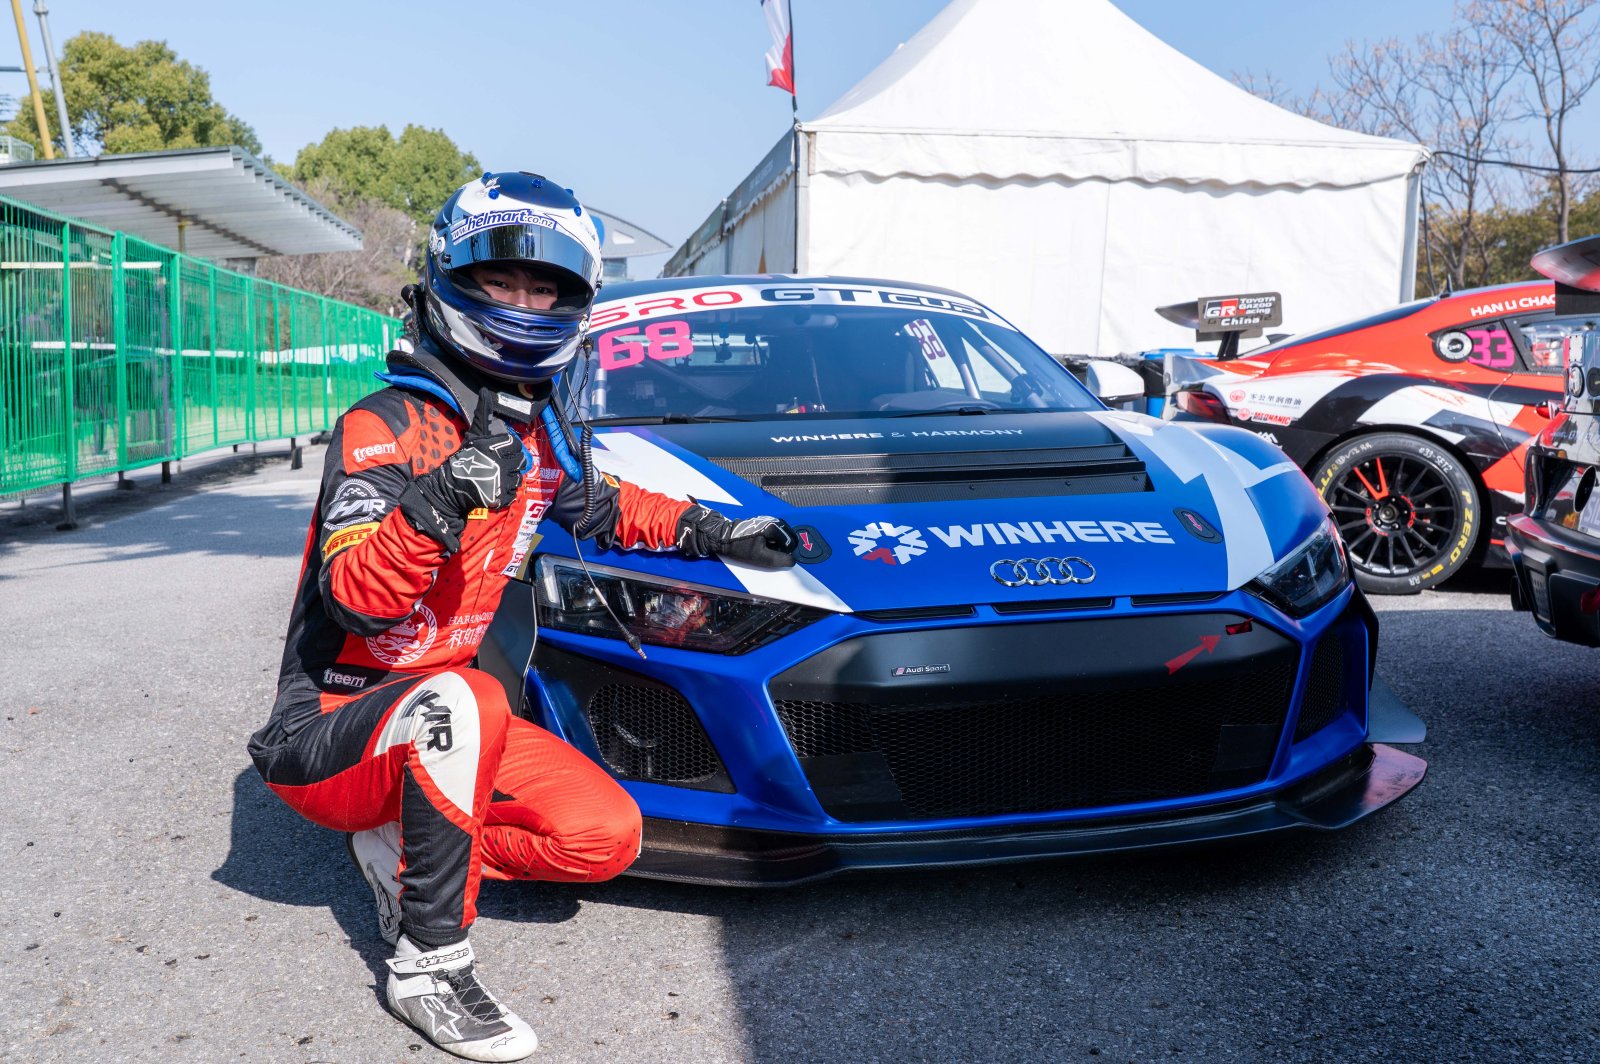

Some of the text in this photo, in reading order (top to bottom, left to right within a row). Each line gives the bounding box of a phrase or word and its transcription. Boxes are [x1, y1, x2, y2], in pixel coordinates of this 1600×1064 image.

[590, 288, 988, 328] SRO GT CUP
[1238, 302, 1273, 311] GAZOO
[1239, 296, 1276, 305] TOYOTA
[1470, 301, 1503, 316] HAN
[1505, 301, 1518, 311] LI
[1206, 305, 1236, 318] GR
[1220, 316, 1260, 327] China
[598, 320, 694, 371] 68
[1467, 330, 1515, 368] 33
[770, 432, 885, 443] WINHERE
[911, 429, 1024, 438] HARMONY
[353, 442, 396, 463] freem
[926, 520, 1176, 549] WINHERE
[1450, 507, 1474, 565] ZERO
[323, 667, 367, 689] freem
[906, 665, 947, 674] Audi Sport
